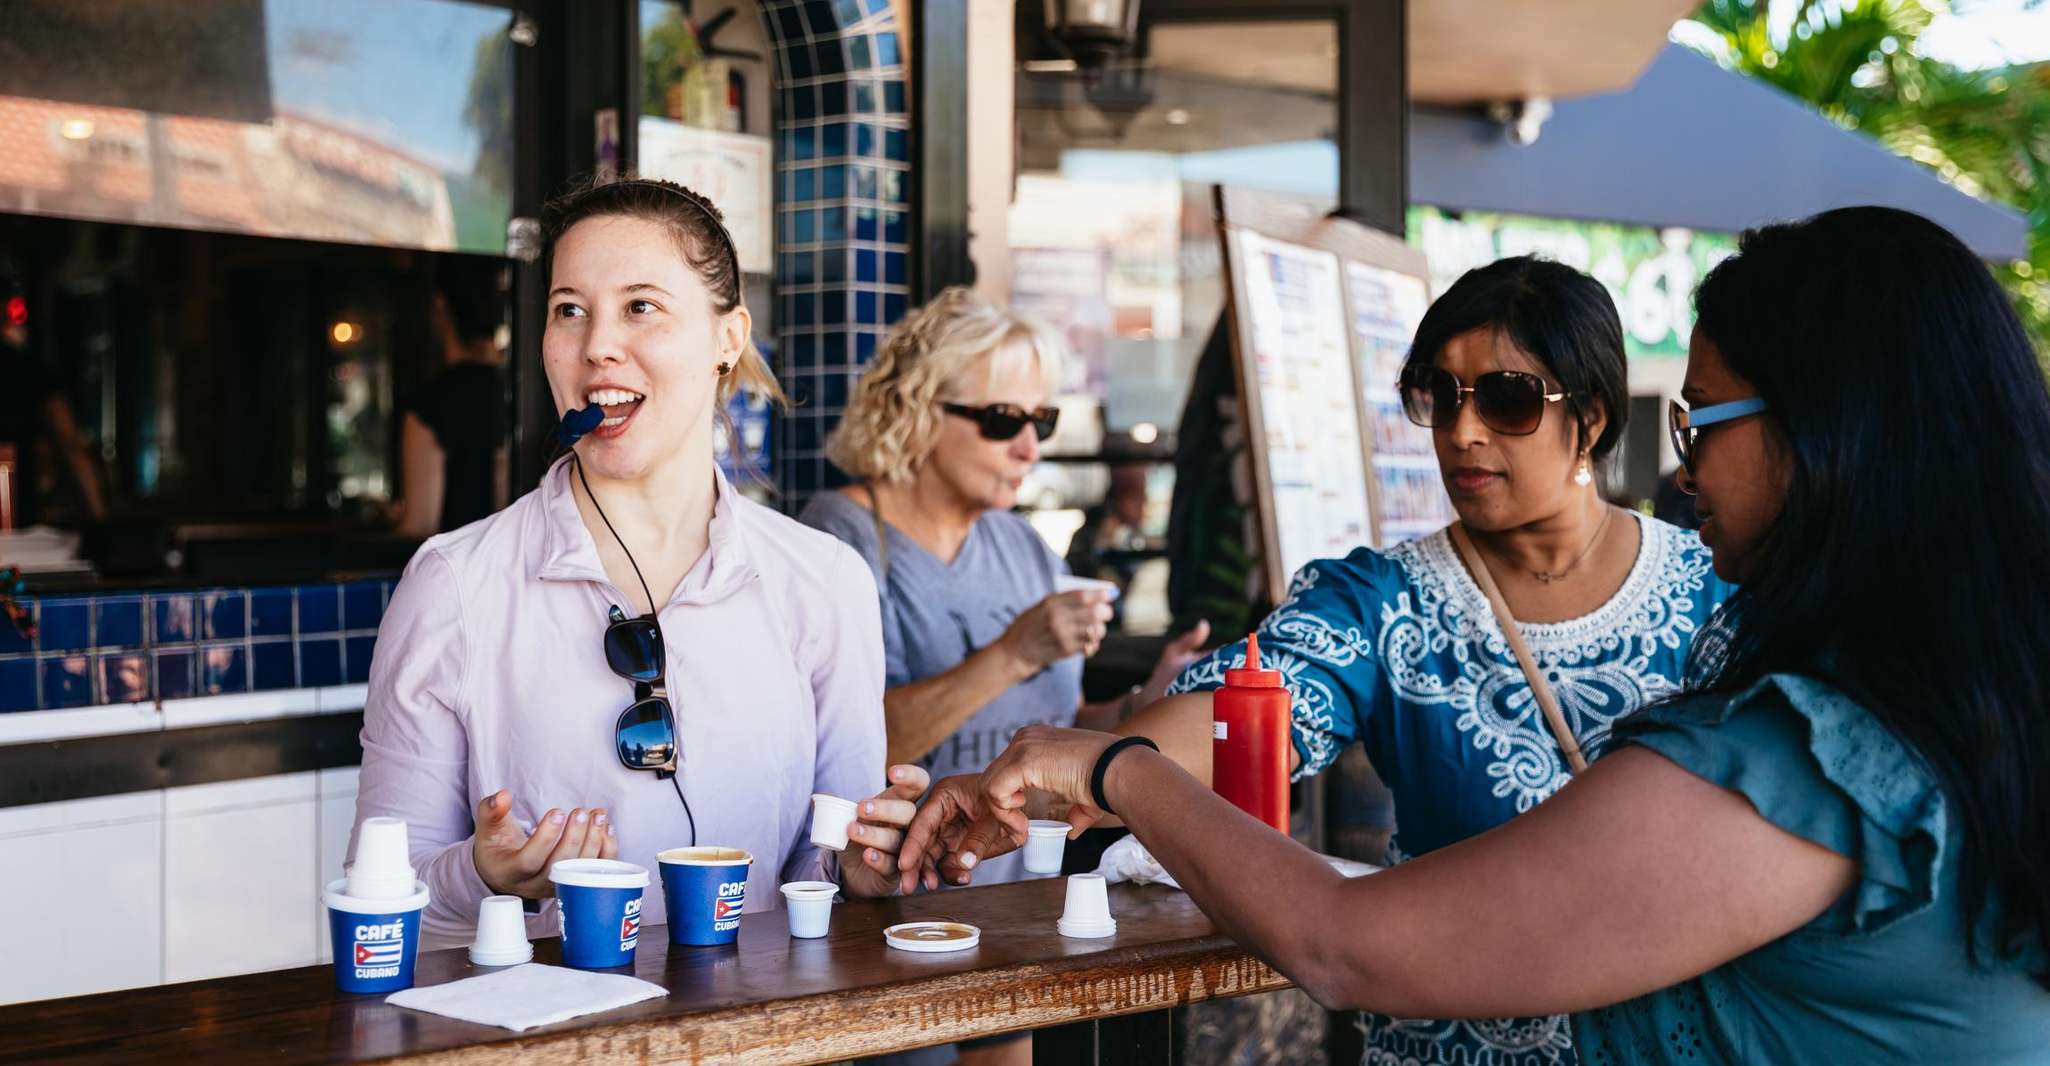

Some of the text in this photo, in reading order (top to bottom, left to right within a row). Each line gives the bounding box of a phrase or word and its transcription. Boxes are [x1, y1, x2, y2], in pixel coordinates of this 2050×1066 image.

[719, 881, 746, 897] CAF
[355, 918, 404, 940] CAFÉ
[355, 966, 400, 979] CUBANO
